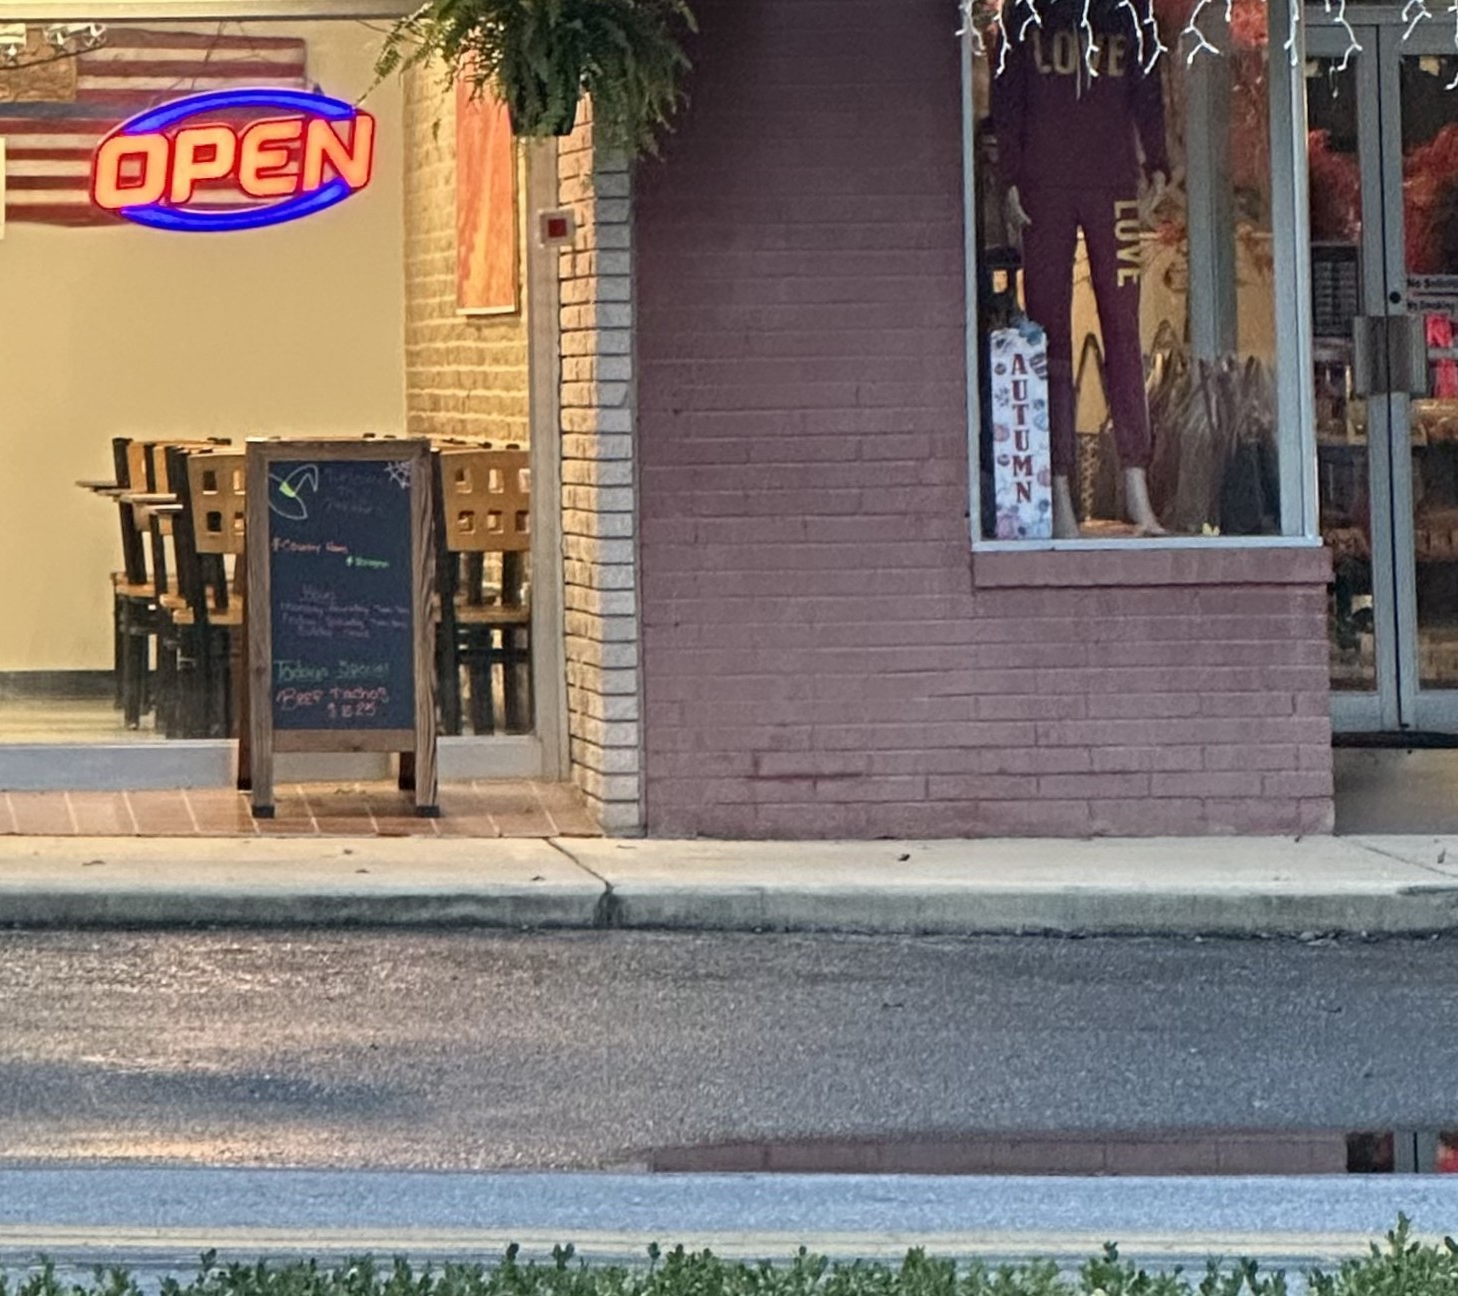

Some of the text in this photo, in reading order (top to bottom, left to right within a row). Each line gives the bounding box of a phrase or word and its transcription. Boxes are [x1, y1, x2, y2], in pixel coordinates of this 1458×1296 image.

[93, 112, 376, 210] OPEN
[1113, 198, 1142, 288] LOVE
[1010, 353, 1034, 504] AUTUMN
